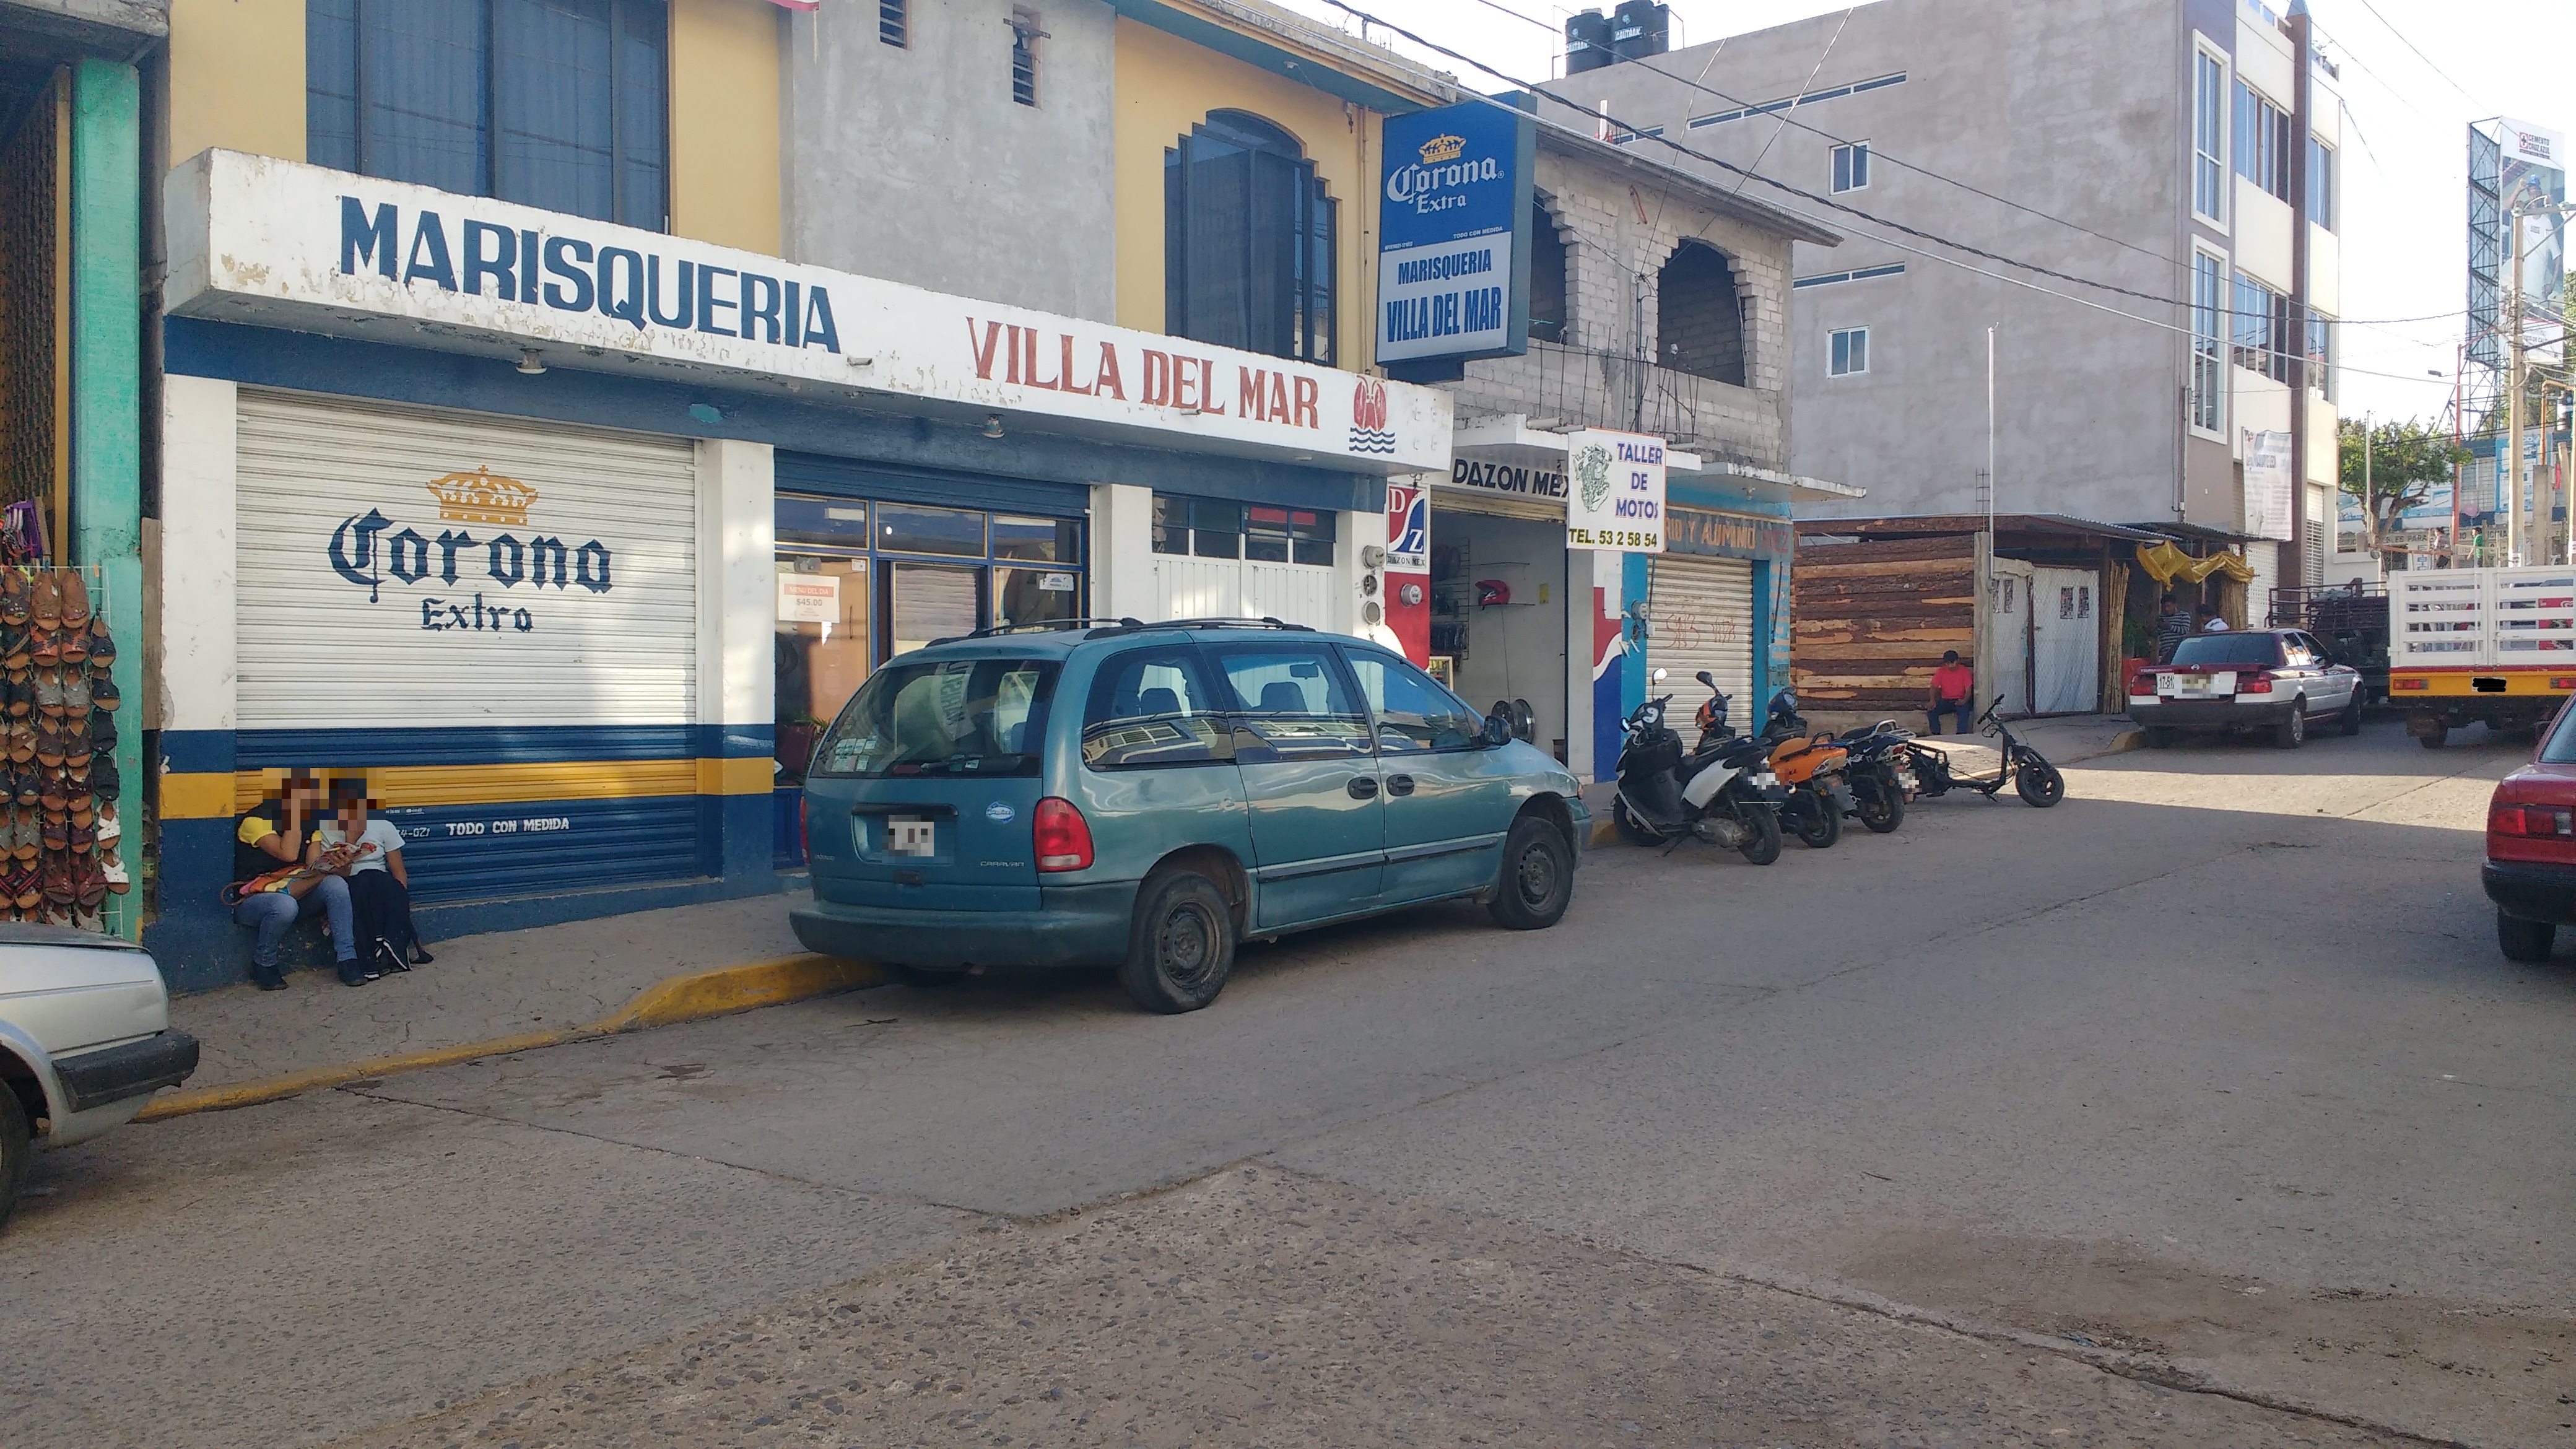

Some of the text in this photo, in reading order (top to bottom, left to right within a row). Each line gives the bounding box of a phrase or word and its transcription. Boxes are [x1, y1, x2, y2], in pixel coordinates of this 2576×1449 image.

[1386, 157, 1498, 204] Corona
[1416, 193, 1467, 214] Extra
[1482, 226, 1503, 235] MEDIDA
[339, 194, 841, 354] MARISQUERIA
[1398, 249, 1492, 285] MARISQUERIA
[1386, 287, 1502, 343] VILLA DEL MAR
[965, 316, 1320, 430] VILLA DEL MAR
[1617, 442, 1663, 466] TALLER
[1451, 458, 1529, 493] DAZON
[1630, 471, 1648, 491] DE
[1615, 497, 1659, 520] MOTOS
[1569, 528, 1658, 548] TEL. 53 2 58 54
[1687, 520, 1695, 542] Y
[328, 507, 614, 603] Corona
[1387, 556, 1425, 566] DAZON MEX
[420, 592, 534, 633] Extra
[796, 598, 822, 606] $45.00
[445, 817, 570, 836] TODO CON MEDIDA
